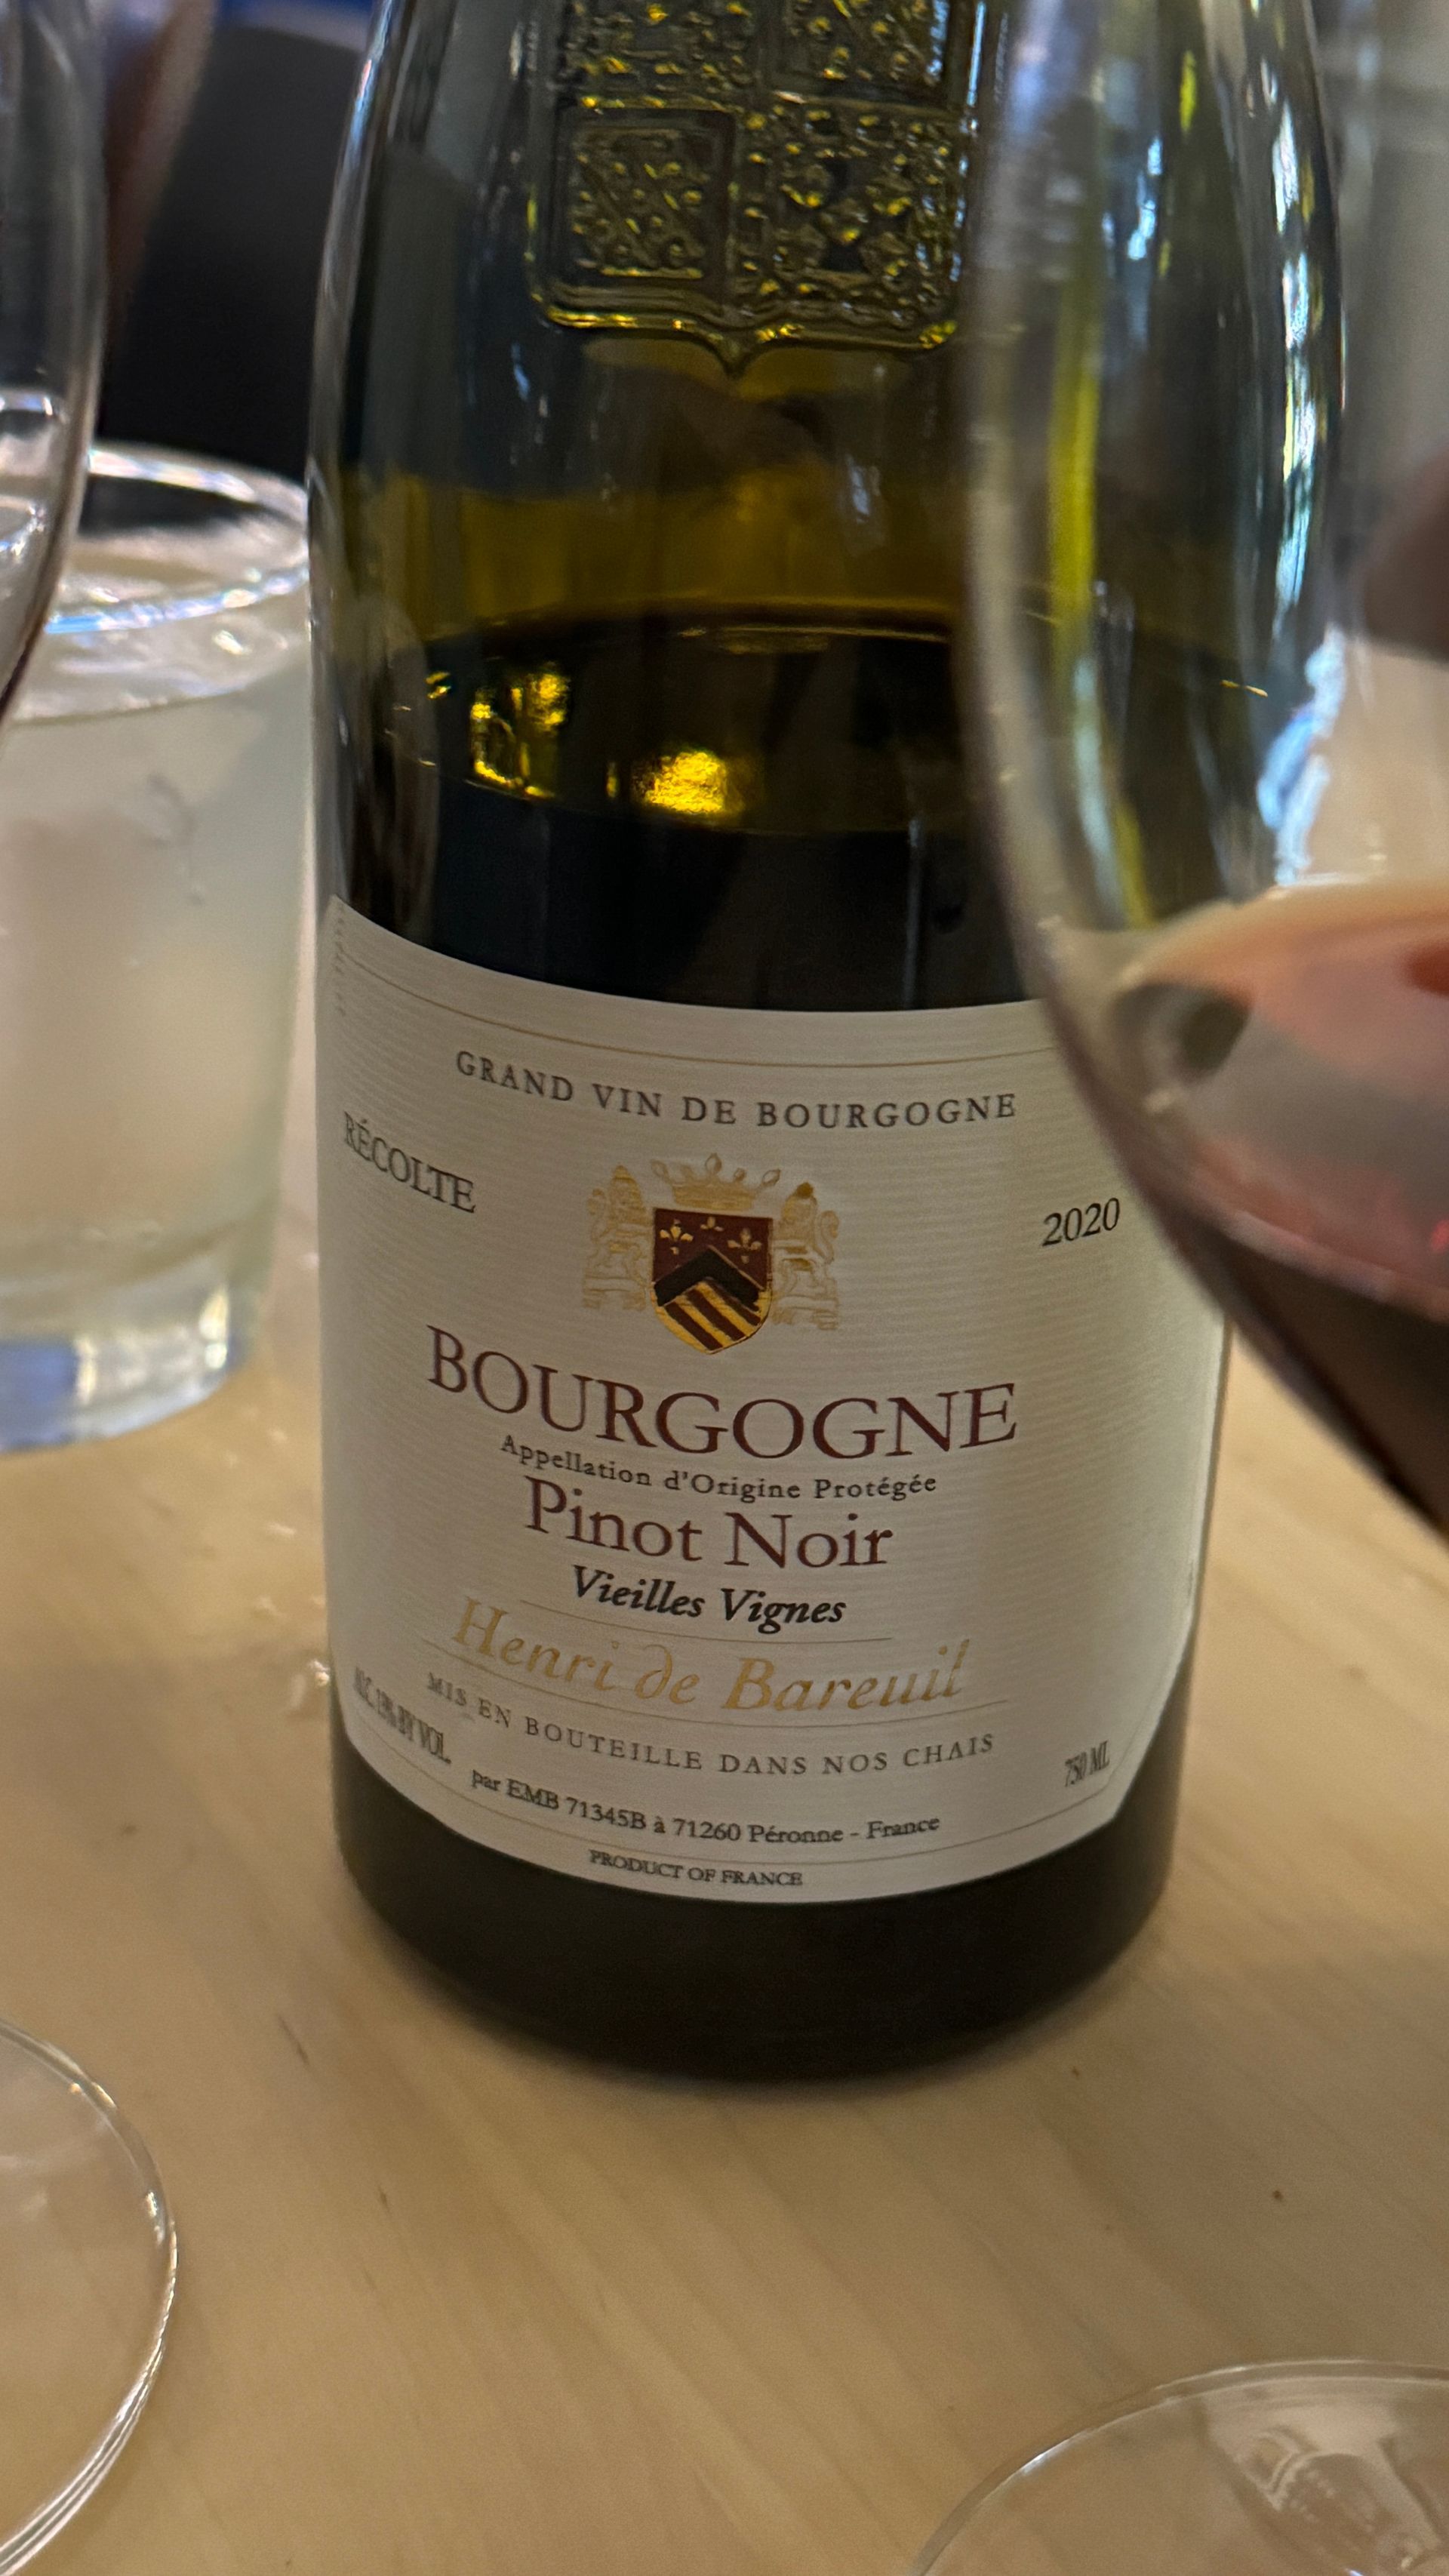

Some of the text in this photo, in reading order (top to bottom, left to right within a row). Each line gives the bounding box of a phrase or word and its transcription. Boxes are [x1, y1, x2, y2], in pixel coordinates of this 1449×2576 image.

[457, 1051, 1016, 1128] GRAND VIN DE BOURGOGNE
[343, 1110, 476, 1214] RÉCOLTE
[1041, 1198, 1120, 1247] 2020
[426, 1325, 1017, 1459] BOURGOGNE
[500, 1434, 937, 1503] Appellation d'Origine Protégée
[524, 1475, 894, 1568] Pinot Noir
[573, 1564, 847, 1634] Vieilles Vignes
[453, 1596, 971, 1712] Henri de Bareuil
[427, 1671, 994, 1776] MIS EN BOUTEILLE DANS NOS CHAIS
[472, 1769, 500, 1791] par
[506, 1778, 559, 1810] EMB
[565, 1796, 647, 1830] 71345B
[654, 1815, 666, 1834] à
[672, 1817, 741, 1841] 71260
[748, 1824, 844, 1843] Péronne
[866, 1817, 940, 1839] France
[589, 1849, 803, 1886] PRODUCT OF FRANCE
